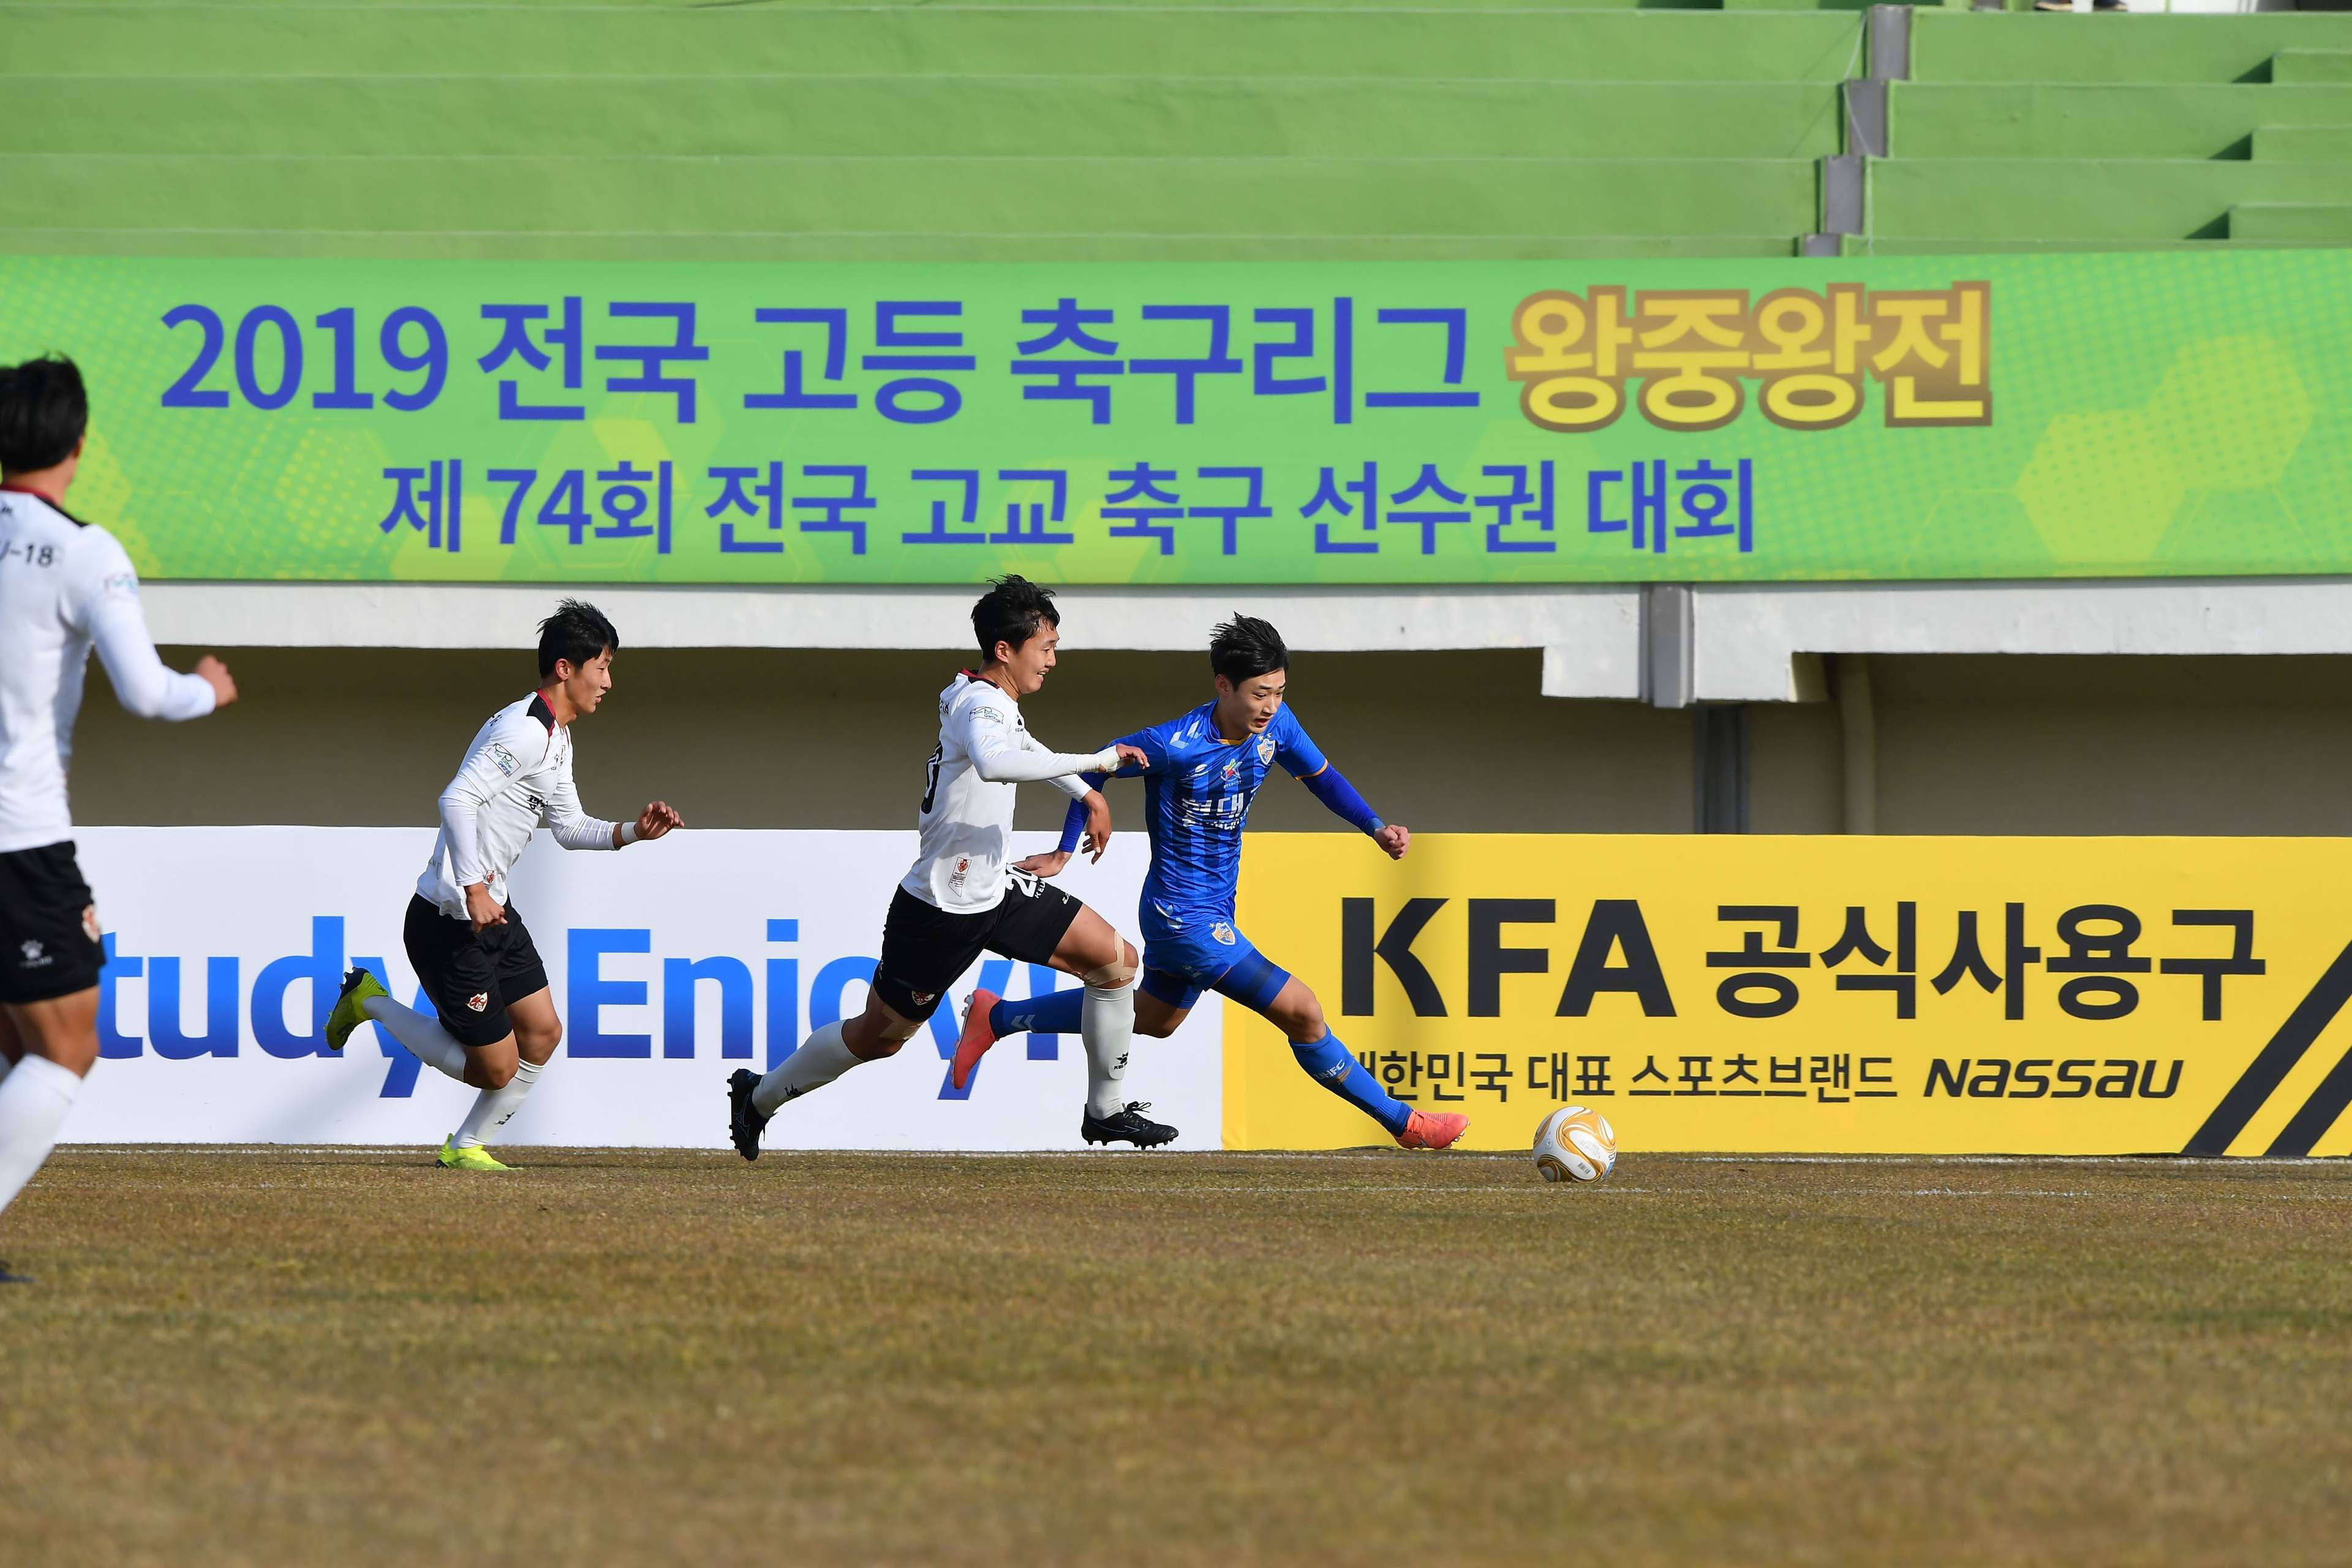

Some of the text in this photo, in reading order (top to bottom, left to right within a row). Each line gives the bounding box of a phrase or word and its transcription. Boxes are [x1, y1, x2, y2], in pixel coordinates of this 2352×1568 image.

[162, 282, 1992, 432] 2019 전국 고등 축구리그 왕중왕전
[380, 458, 1753, 556] 제 74회 전국 고교 축구 선수권 대회
[98, 916, 440, 1098] tudy
[1341, 897, 2266, 1021] KFA 공식사용구
[1528, 1051, 1615, 1102] 대표
[1628, 1053, 1898, 1104] 스포츠브랜드
